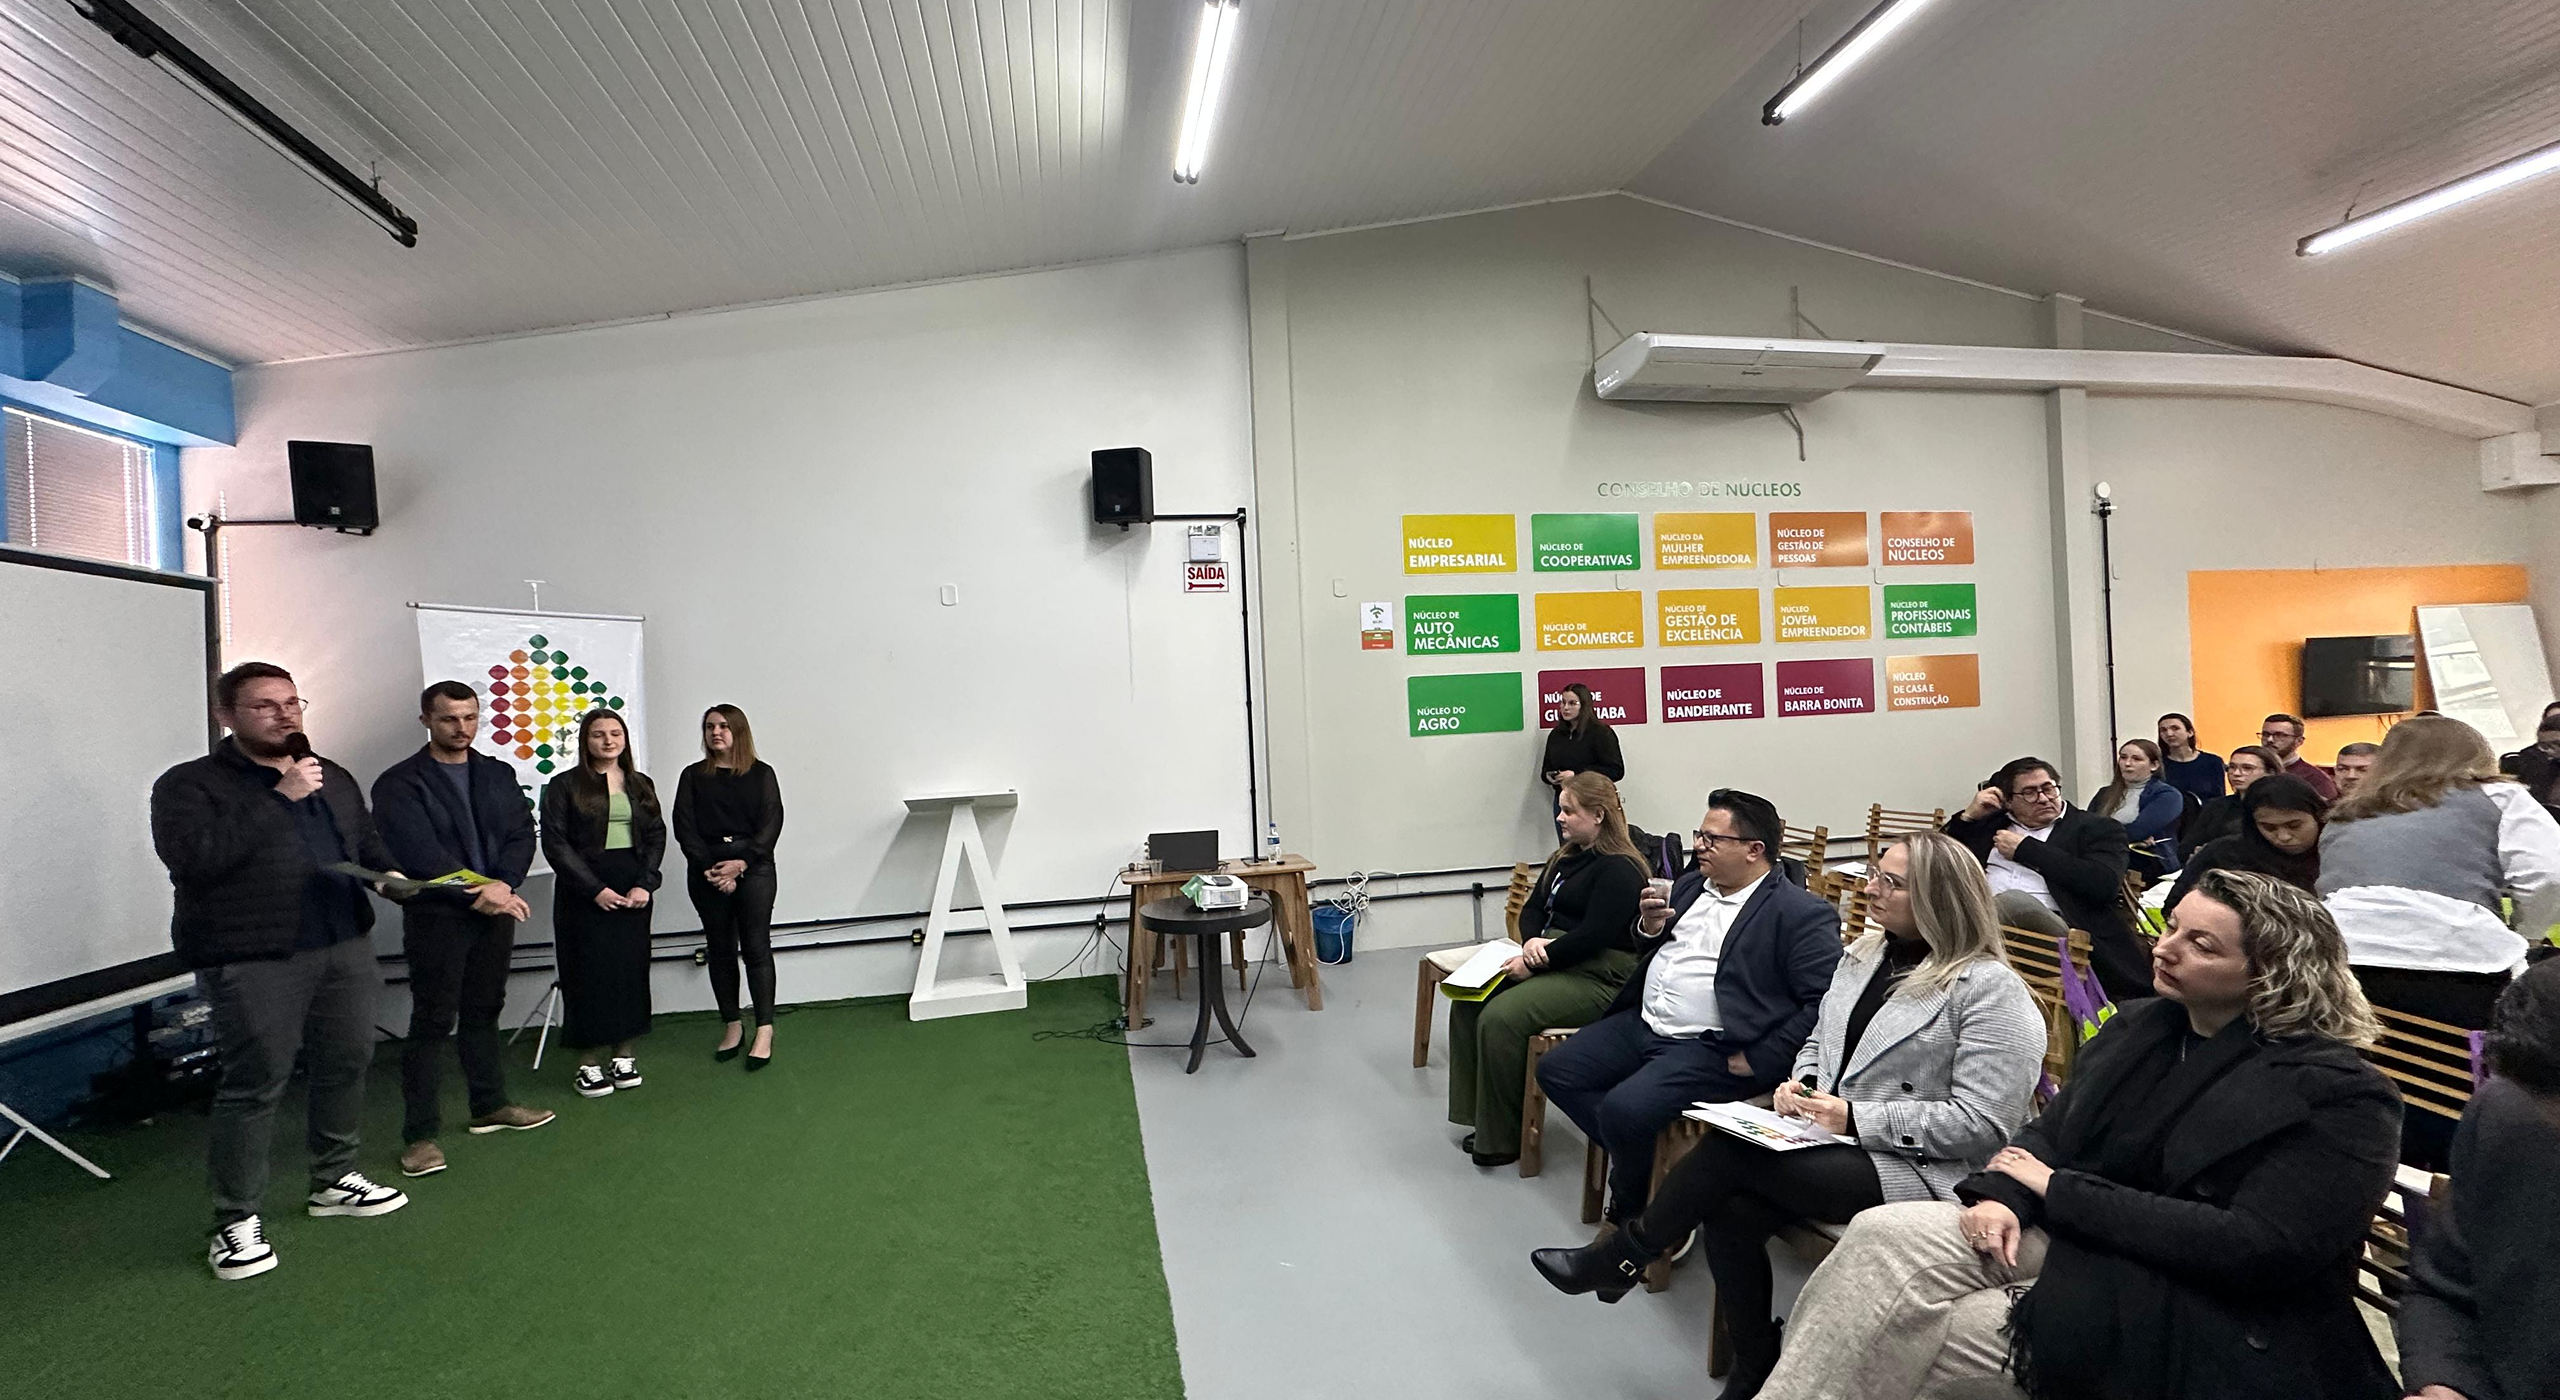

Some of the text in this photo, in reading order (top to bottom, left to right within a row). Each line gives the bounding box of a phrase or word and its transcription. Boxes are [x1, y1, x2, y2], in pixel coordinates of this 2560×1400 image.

[1597, 478, 1801, 498] CONSELHO DE NÚCLEOS
[1661, 533, 1704, 541] NÚCLEO DA
[1777, 528, 1825, 538] NÚCLEO DE
[1408, 537, 1453, 549] NÚCLEO
[1540, 543, 1583, 551] NÚCLEO DE
[1661, 543, 1704, 553] MULHER
[1777, 540, 1824, 550] GESTÃO DE
[1888, 537, 1955, 548] CONSELHO DE
[1662, 554, 1752, 565] EMPREENDEDORA
[1778, 553, 1817, 563] PESSOAS
[1888, 547, 1944, 561] NÚCLEOS
[1409, 554, 1506, 568] EMPRESARIAL
[1540, 554, 1633, 567] COOPERATIVAS
[1187, 565, 1225, 580] SAÍDA
[1665, 605, 1707, 613] NÚCLEO DE
[1780, 604, 1809, 613] NÚCLEO
[1890, 600, 1928, 608] NÚCLEO DE
[1413, 611, 1460, 620] NÚCLEO DE
[1665, 612, 1738, 627] GESTÃO DE
[1781, 615, 1817, 626] JOVEM
[1891, 608, 1971, 621] PROFISSIONAIS
[1413, 621, 1455, 635] AUTO
[1543, 623, 1587, 632] NÚCLEO DE
[1781, 625, 1867, 638] EMPREENDEDOR
[1891, 620, 1952, 634] CONTÁBEIS
[1544, 631, 1635, 646] E-COMMERCE
[1666, 626, 1744, 642] EXCELÊNCIA
[1414, 632, 1500, 650] MECÂNICAS
[1892, 672, 1926, 682] NÚCLEO
[1666, 688, 1722, 701] NÚCLEO DE
[1784, 686, 1825, 695] NÚCLEO DE
[1893, 684, 1935, 694] DE CASA E
[1784, 697, 1864, 712] BARRA BONITA
[1893, 695, 1950, 708] CONSTRUÇÃO
[1416, 706, 1466, 716] NÚCLEO DO
[1667, 703, 1753, 719] BANDEIRANTE
[1417, 717, 1460, 731] AGRO
